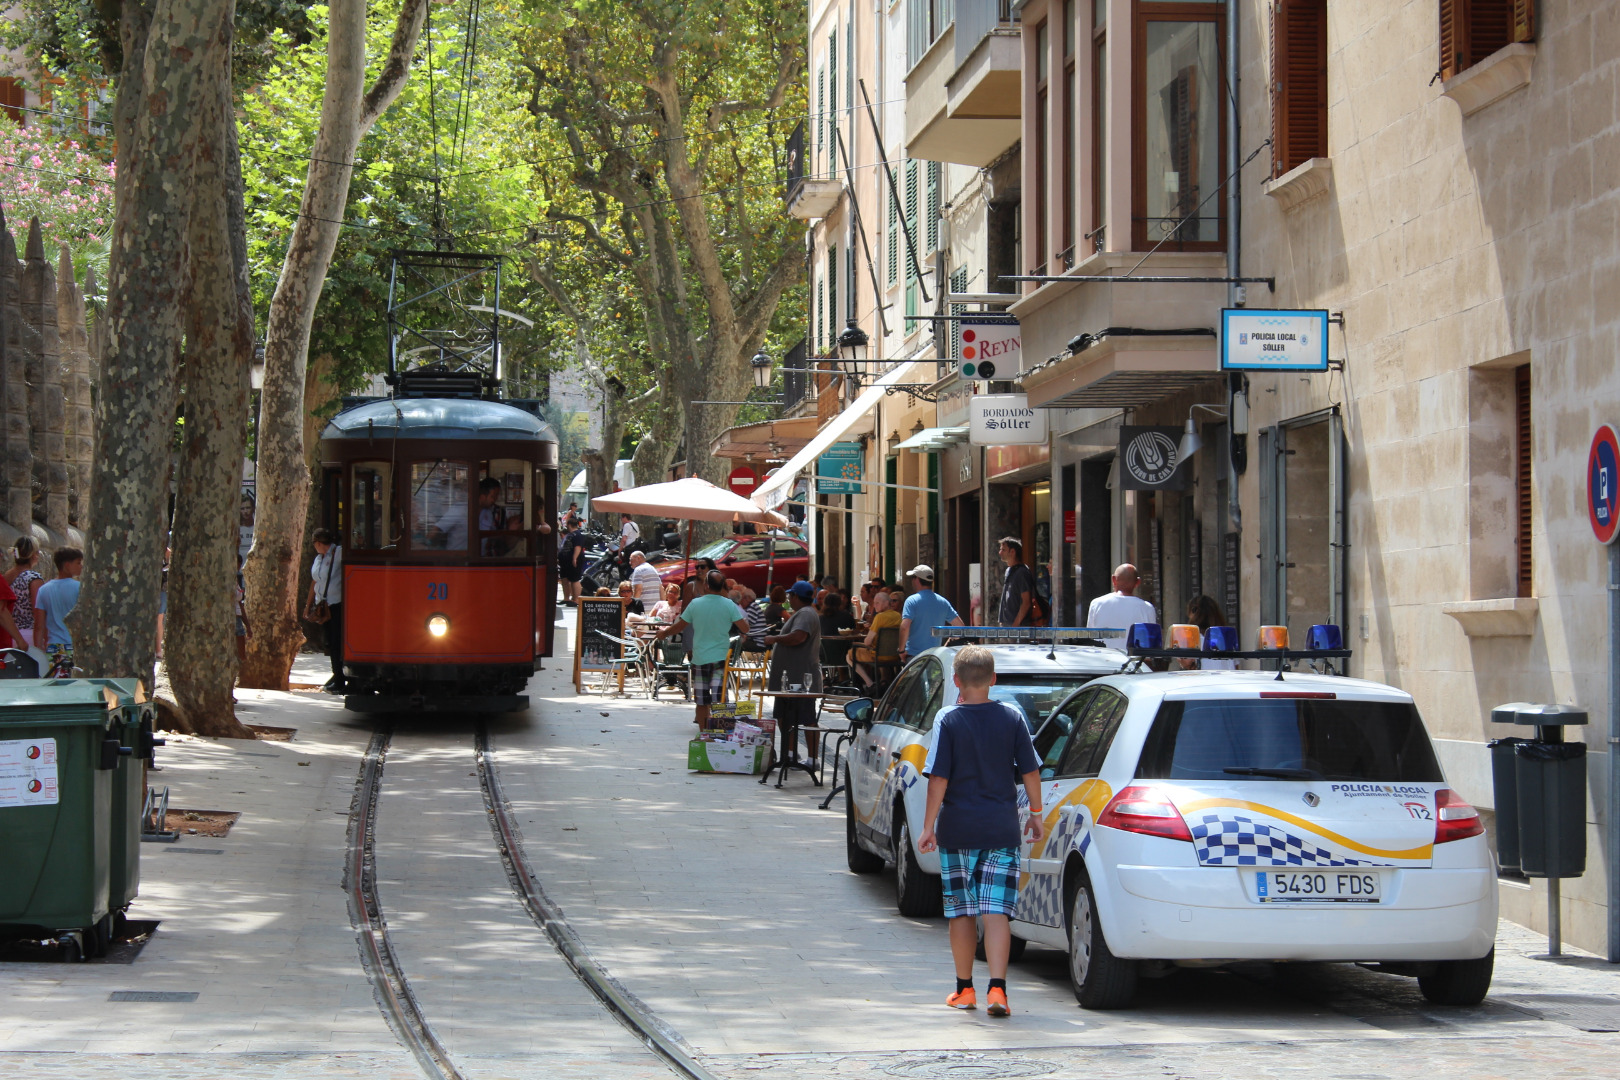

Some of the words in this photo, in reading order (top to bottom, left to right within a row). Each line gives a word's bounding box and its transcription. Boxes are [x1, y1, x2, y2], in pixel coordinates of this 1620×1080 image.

[1251, 332, 1275, 341] POLICIA
[1277, 333, 1296, 341] LOCAL
[983, 408, 1034, 418] BORDADOS
[985, 418, 1031, 429] Sóller
[1132, 465, 1147, 480] FORN
[1149, 473, 1157, 481] DE
[1158, 467, 1171, 480] CAN
[427, 582, 448, 600] 20
[1331, 784, 1383, 792] POLICIA
[1393, 786, 1429, 794] LOCAL
[1405, 806, 1433, 820] 112
[1275, 874, 1326, 894] 5430
[1337, 874, 1375, 894] FDS
